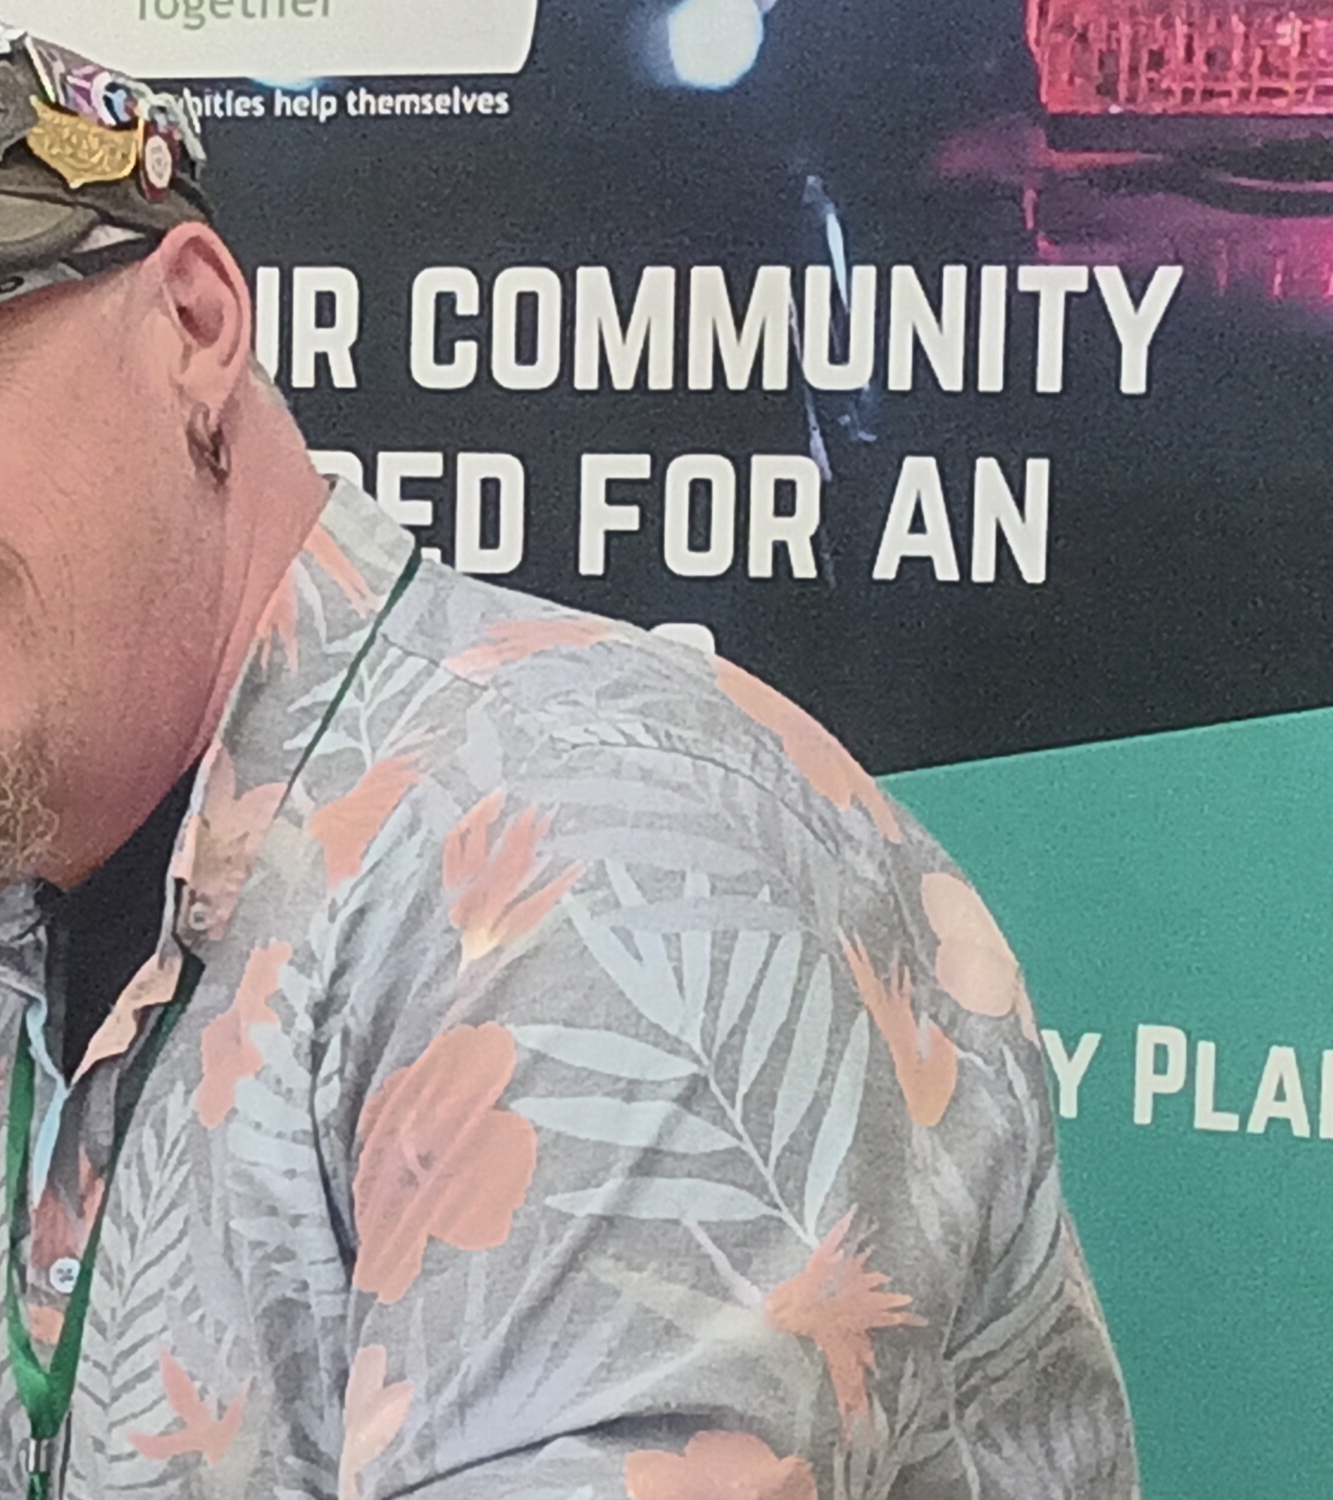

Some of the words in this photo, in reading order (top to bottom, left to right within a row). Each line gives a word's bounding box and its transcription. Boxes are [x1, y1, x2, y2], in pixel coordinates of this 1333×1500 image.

[274, 87, 337, 122] help
[347, 85, 511, 117] themselves
[410, 265, 1184, 393] COMMUNITY
[578, 453, 821, 579] FOR
[873, 456, 1051, 583] AN
